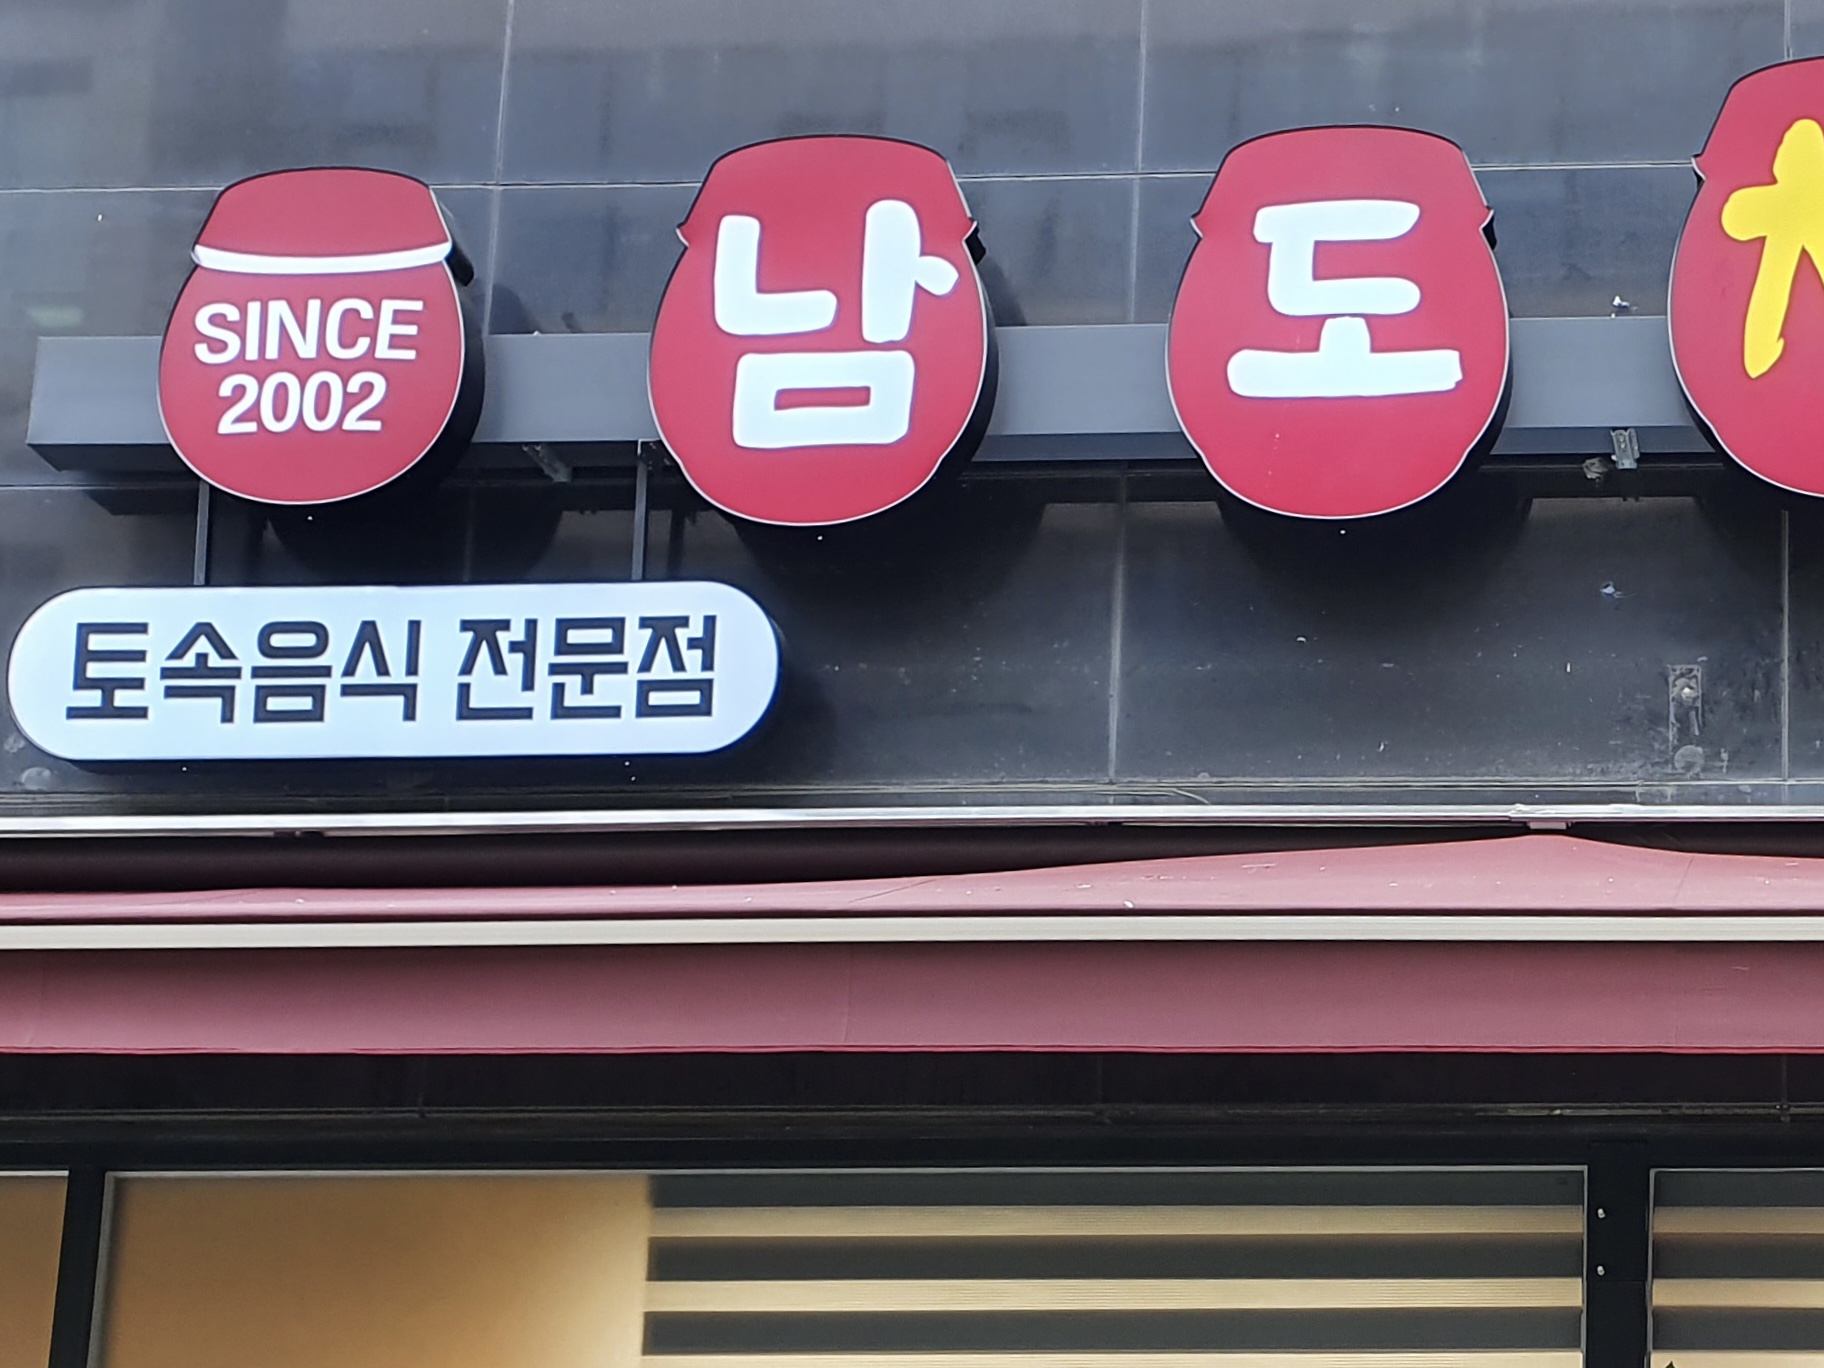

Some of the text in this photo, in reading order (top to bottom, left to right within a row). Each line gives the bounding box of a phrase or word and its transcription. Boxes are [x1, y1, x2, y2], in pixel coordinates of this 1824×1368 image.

[193, 298, 423, 365] SINCE
[217, 371, 387, 434] 2002
[65, 614, 717, 725] 토속음식 전문점
